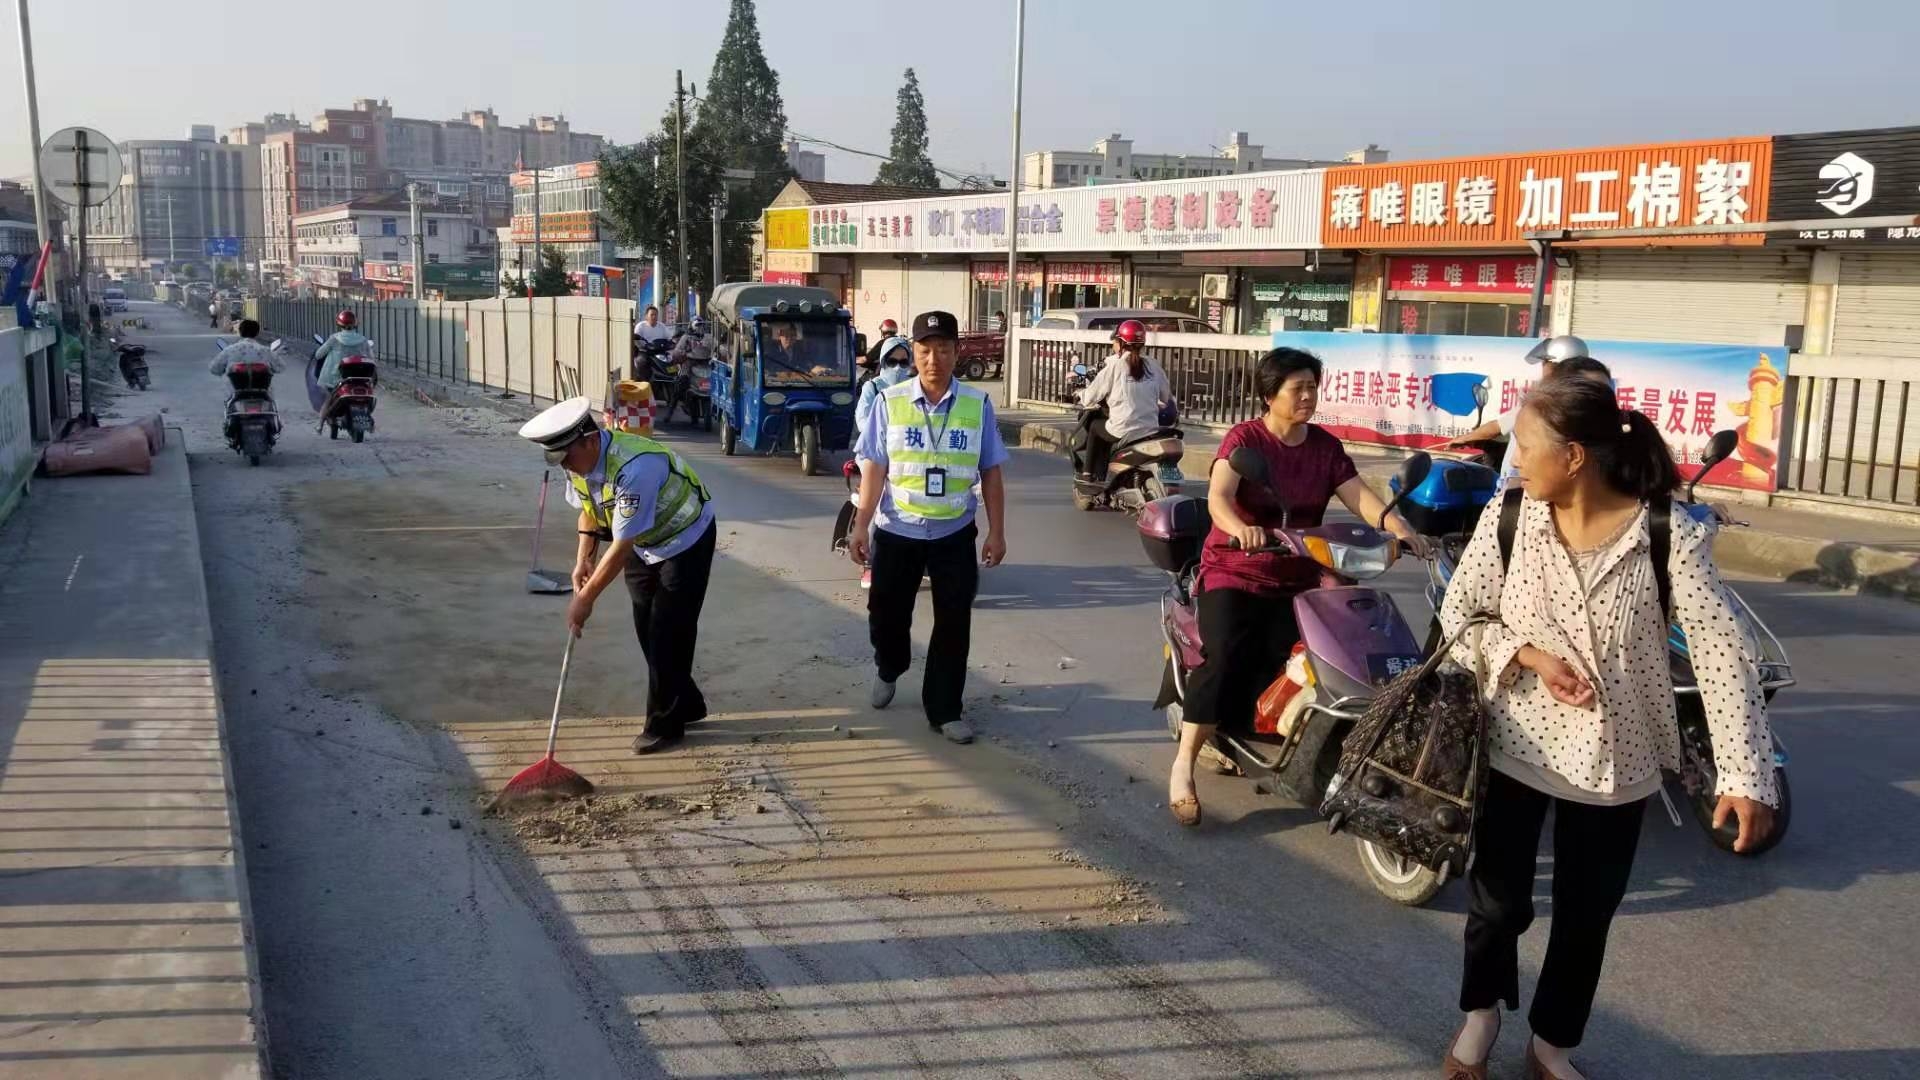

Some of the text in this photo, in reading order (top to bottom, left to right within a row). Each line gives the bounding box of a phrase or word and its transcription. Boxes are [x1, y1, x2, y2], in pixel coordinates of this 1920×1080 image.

[1096, 188, 1278, 233] 景德缝制设备
[1330, 175, 1496, 229] 蒋唯眼镜
[1516, 158, 1752, 228] 加工棉絮
[1410, 263, 1536, 288] 蒋唯眼镜
[1401, 304, 1419, 335] 验
[905, 427, 968, 451] 执勤
